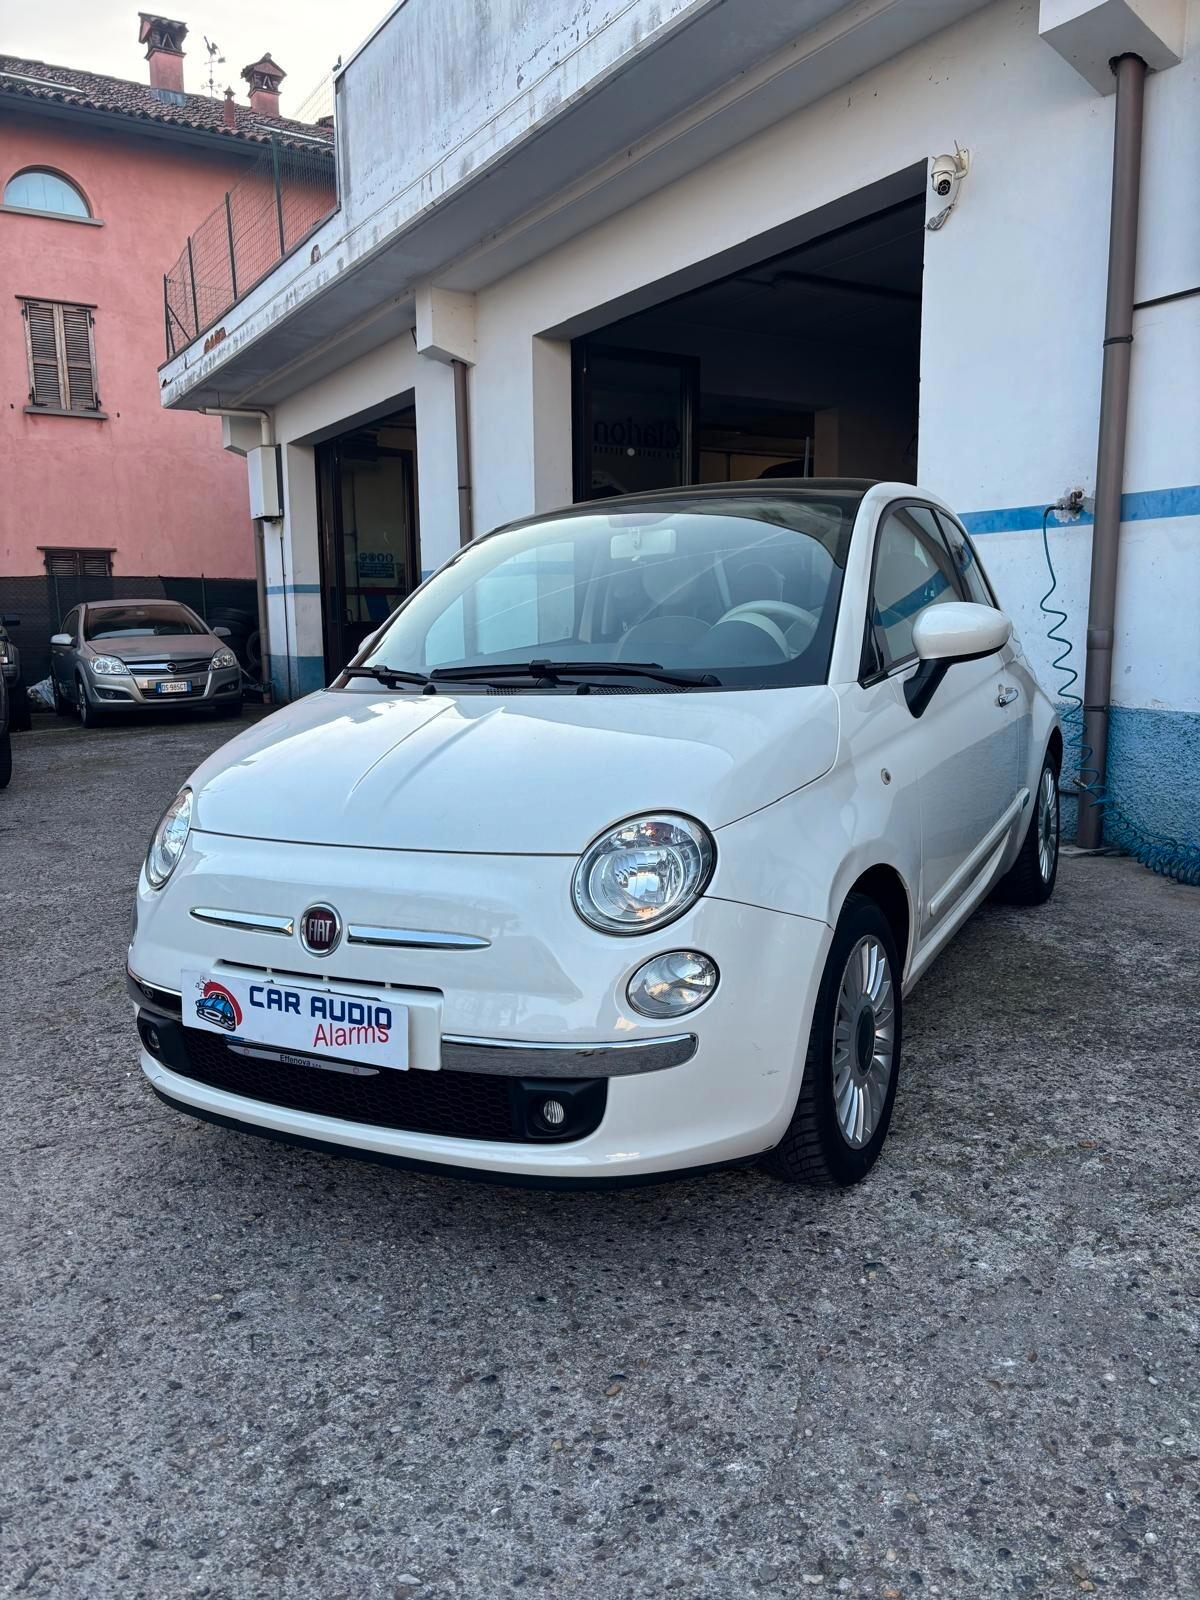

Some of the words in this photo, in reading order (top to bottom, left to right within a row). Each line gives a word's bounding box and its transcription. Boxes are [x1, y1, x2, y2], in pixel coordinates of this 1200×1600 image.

[308, 918, 333, 942] FIAT
[249, 985, 302, 1015] CAR
[310, 996, 392, 1030] AUDIO
[313, 1023, 389, 1047] Alarms
